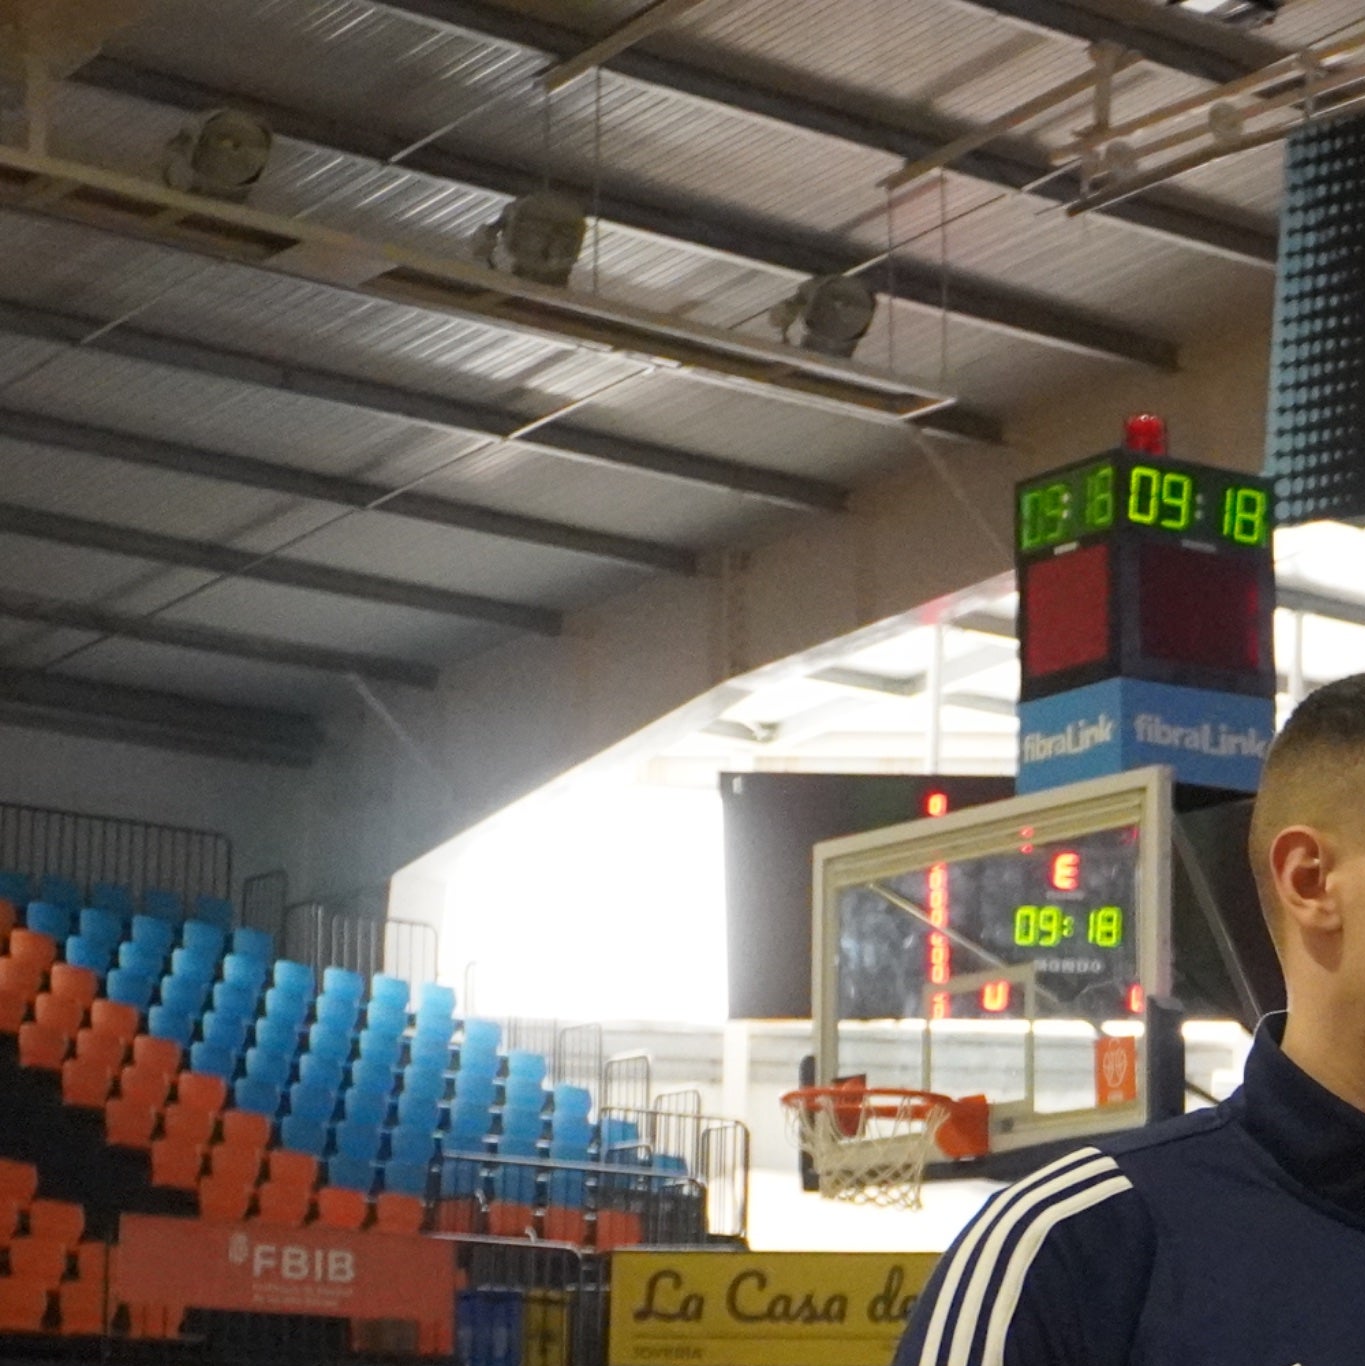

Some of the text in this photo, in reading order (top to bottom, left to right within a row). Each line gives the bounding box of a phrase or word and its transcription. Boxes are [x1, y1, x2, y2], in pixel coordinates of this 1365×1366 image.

[1023, 713, 1113, 763] fibraLink
[1014, 904, 1122, 947] 09:18
[253, 1244, 356, 1283] FBIB
[633, 1269, 704, 1323] La
[725, 1269, 848, 1324] Casa
